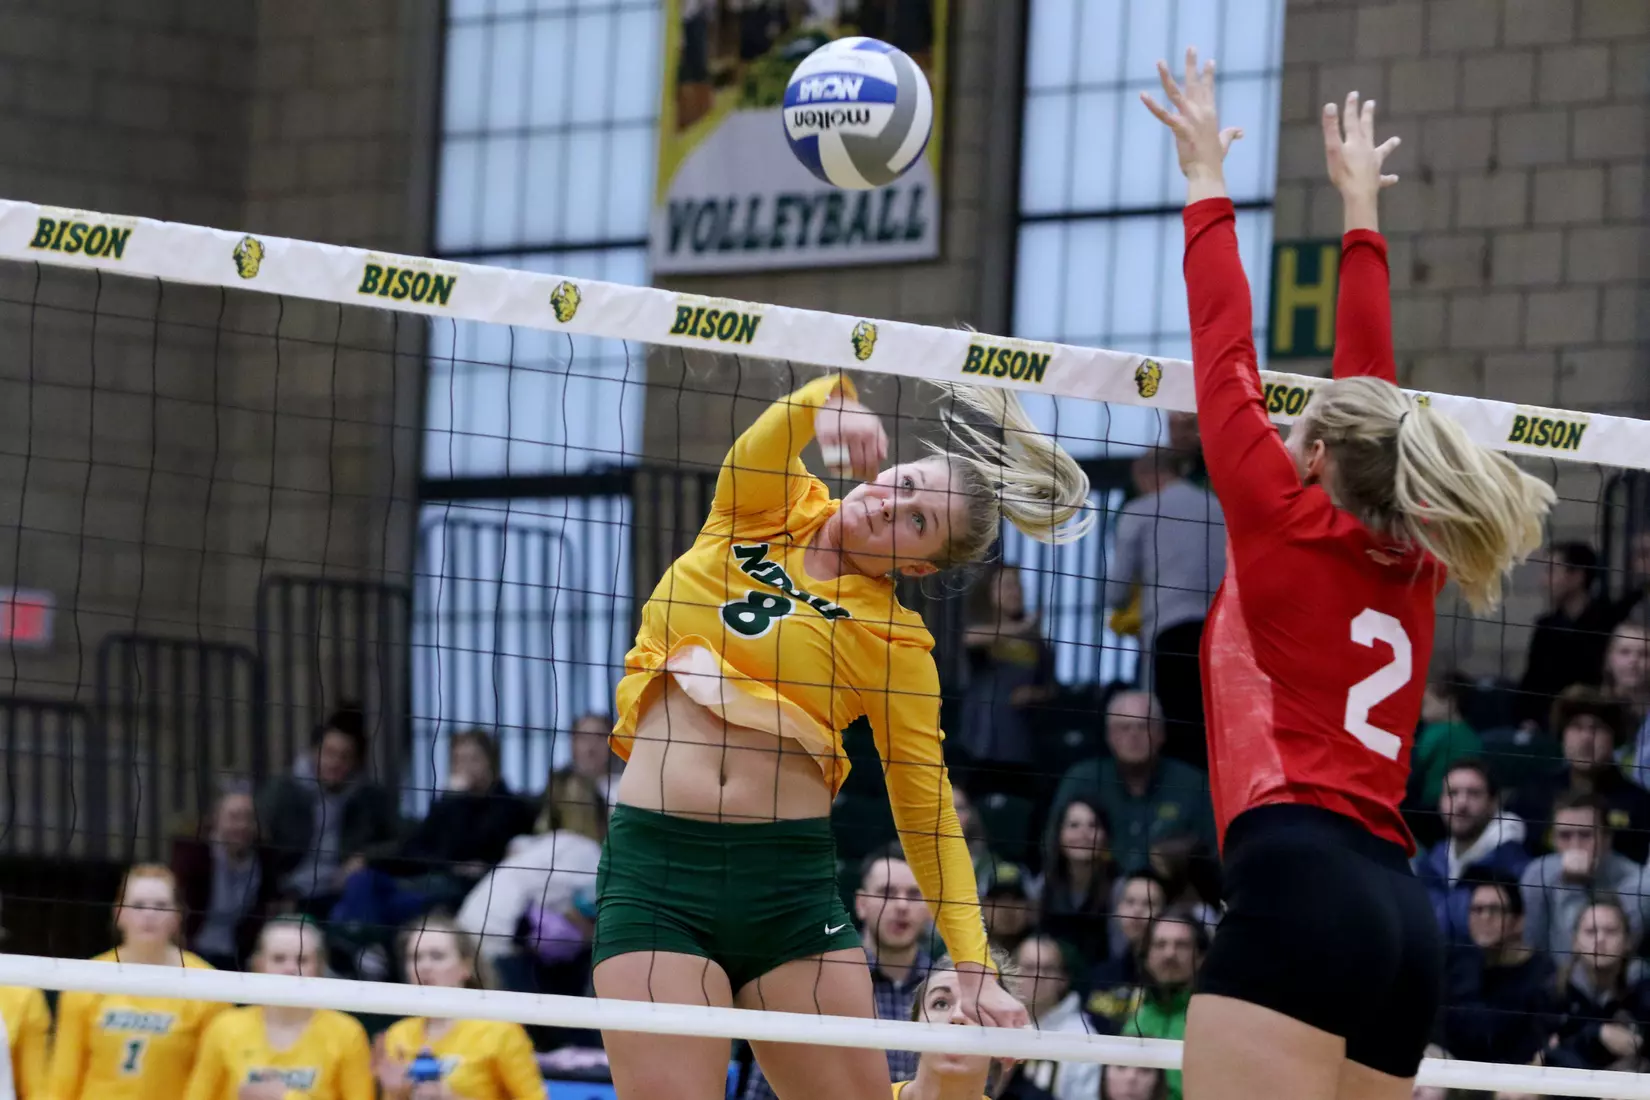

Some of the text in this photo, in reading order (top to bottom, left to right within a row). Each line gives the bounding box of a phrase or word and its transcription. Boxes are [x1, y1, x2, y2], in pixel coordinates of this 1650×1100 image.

[794, 108, 871, 129] molten
[29, 216, 133, 260] BISON
[666, 184, 927, 257] VOLLEYBALL
[357, 263, 458, 306] BISON
[668, 304, 762, 345] BISON
[961, 343, 1052, 384] BISON
[1264, 383, 1315, 416] ISO
[1506, 414, 1588, 451] BISON
[718, 589, 797, 641] 8
[1344, 607, 1413, 761] 2
[120, 1038, 148, 1074] 1
